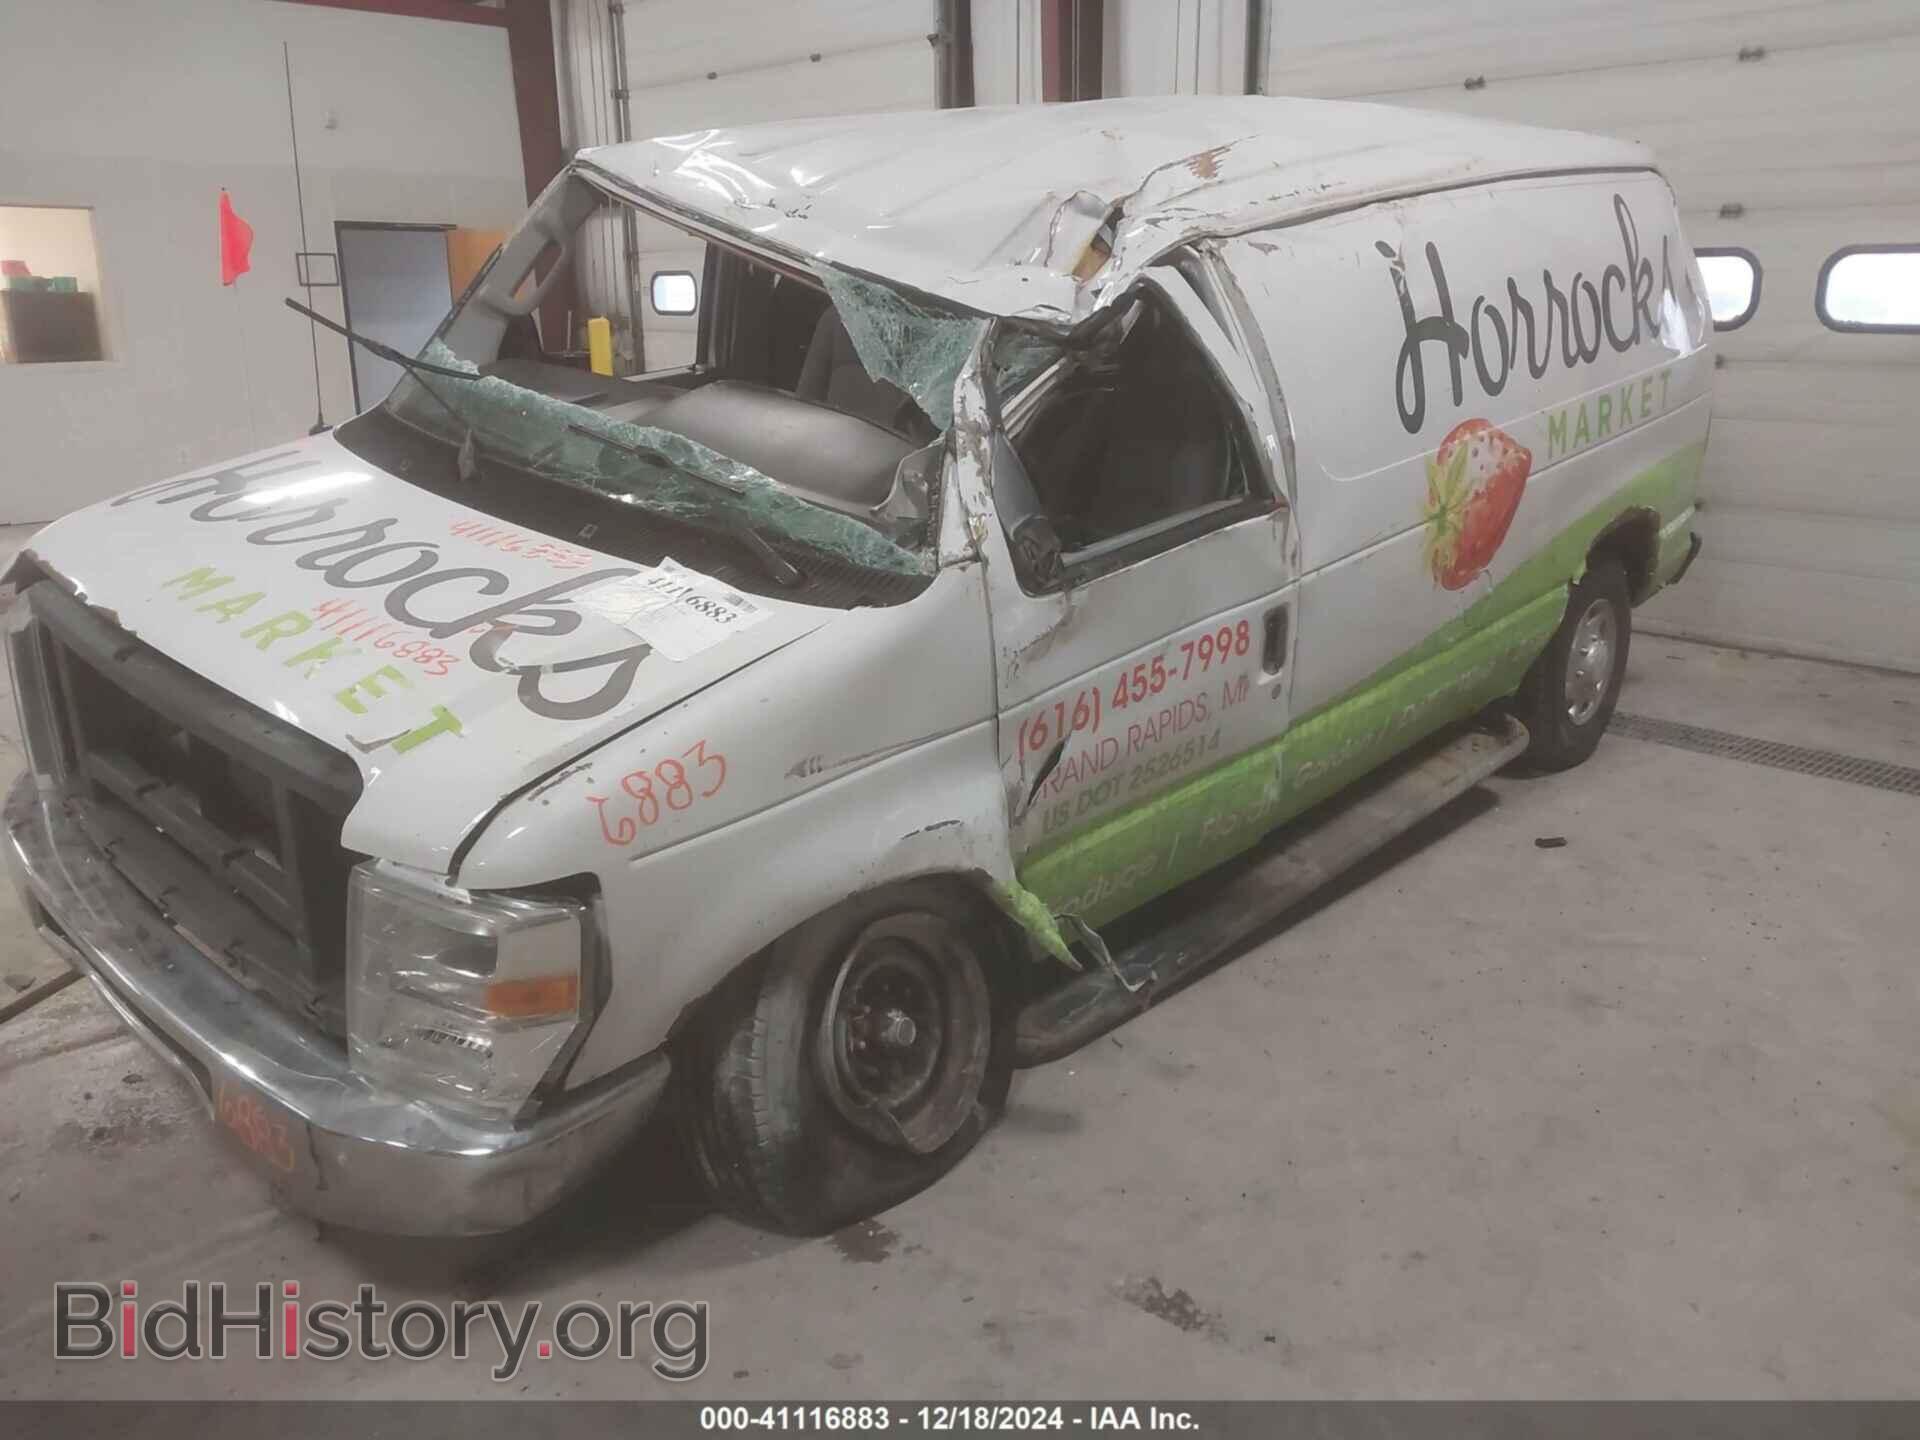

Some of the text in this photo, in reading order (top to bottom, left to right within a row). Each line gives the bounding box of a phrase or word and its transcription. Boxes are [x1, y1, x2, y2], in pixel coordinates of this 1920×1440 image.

[1547, 369, 1673, 460] MARKET
[159, 566, 464, 756] MARKET
[1018, 619, 1250, 762] (616) 455-7998
[585, 739, 727, 846] 6883
